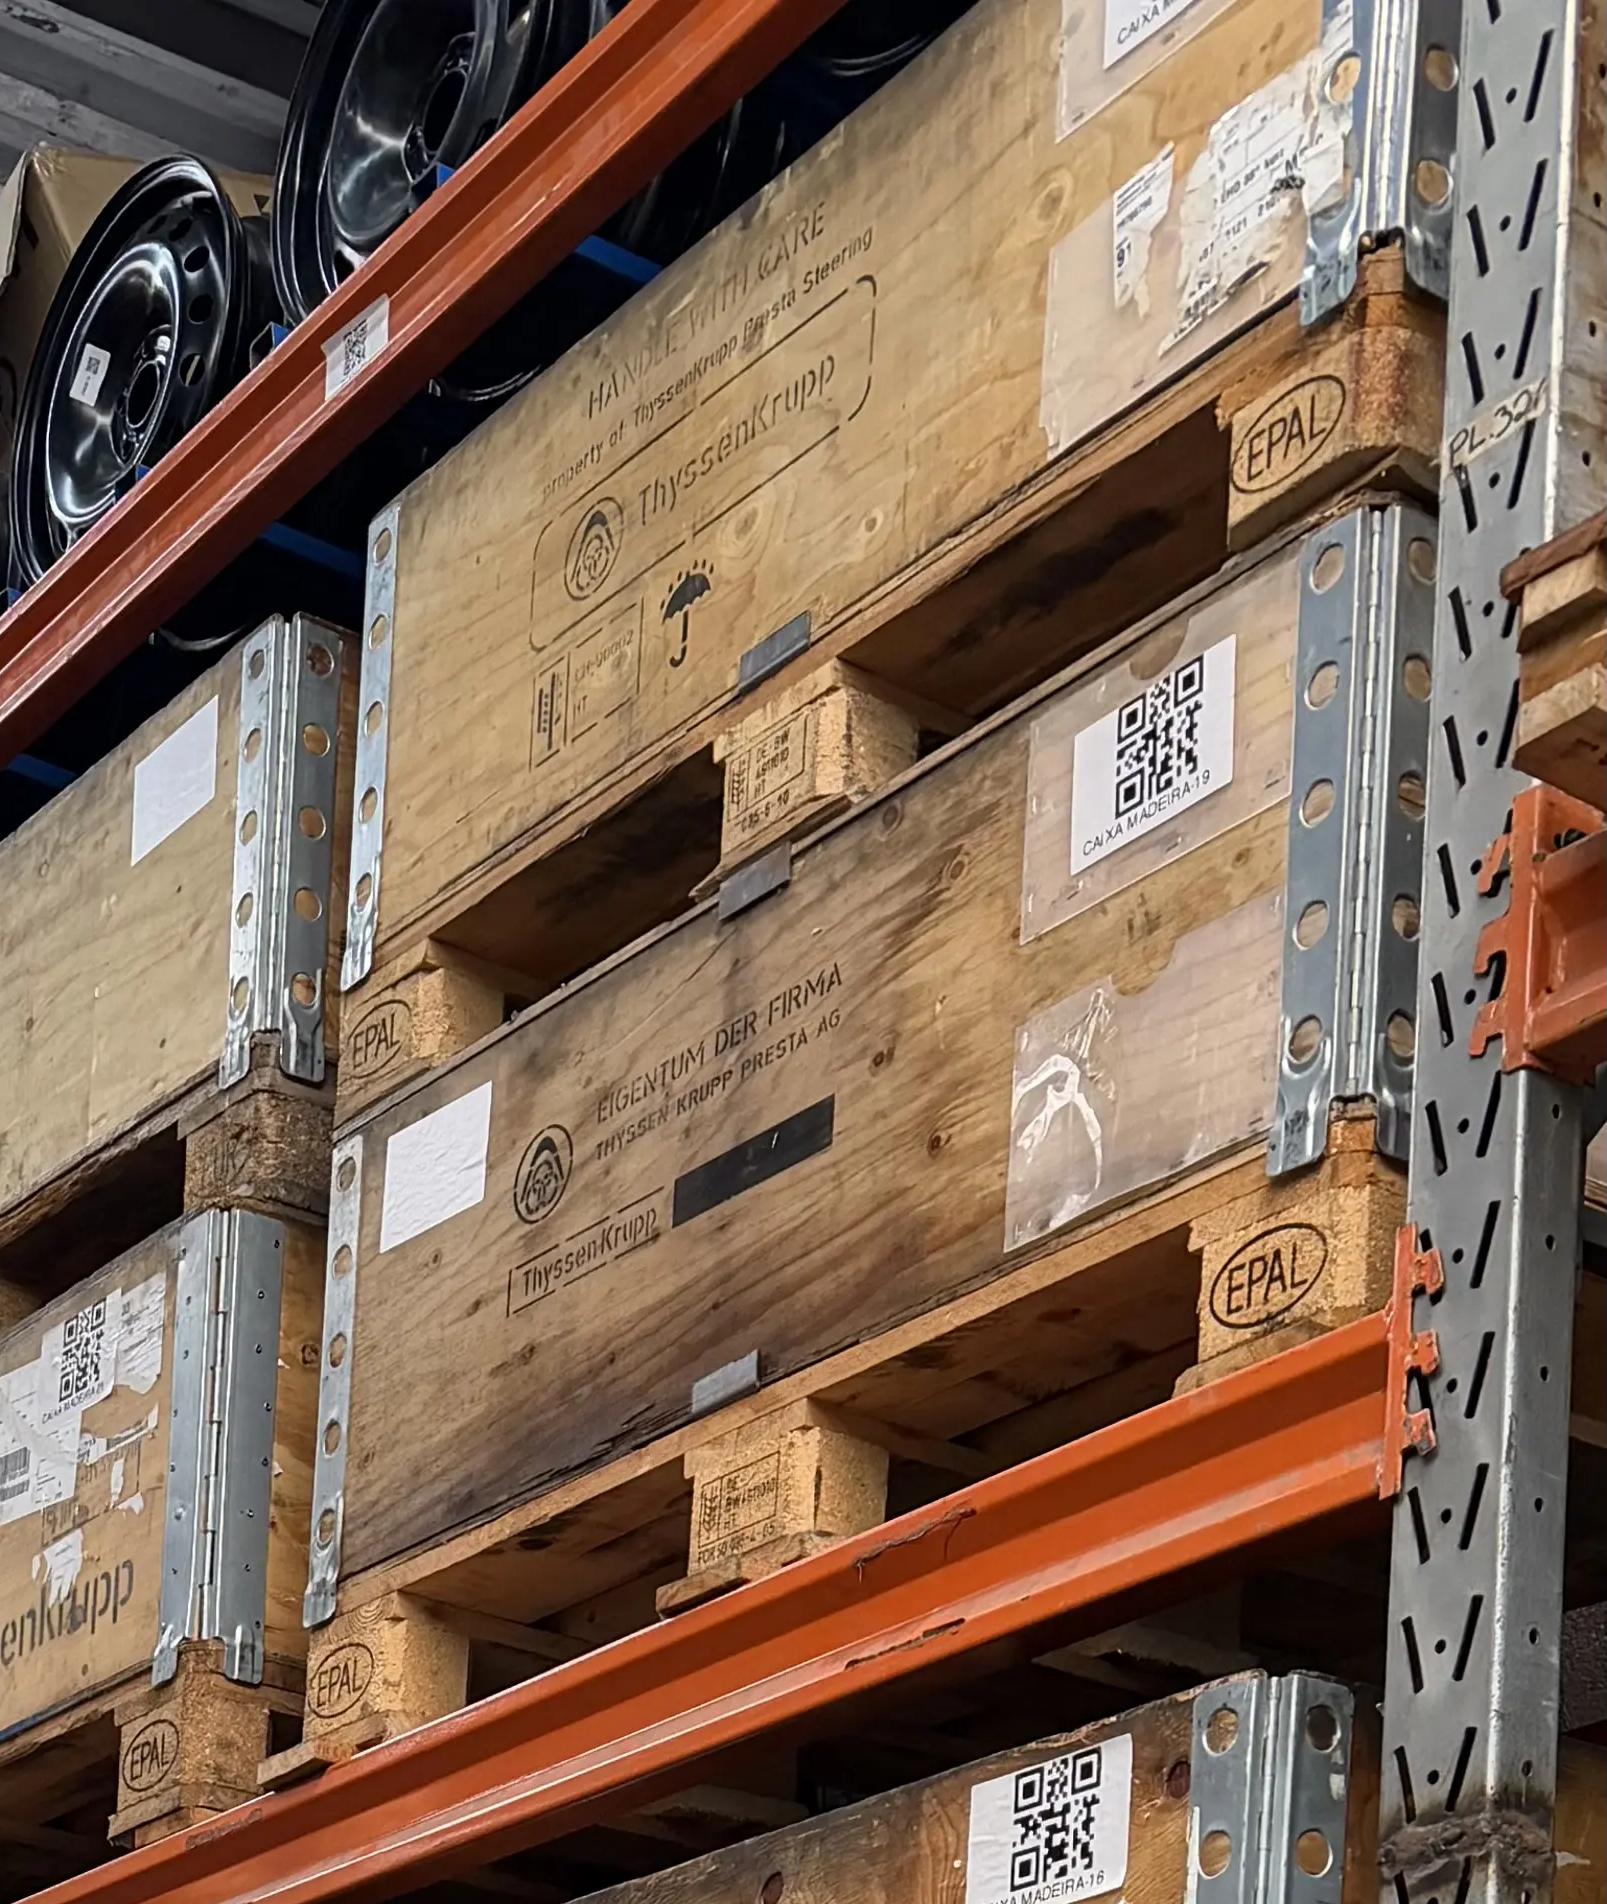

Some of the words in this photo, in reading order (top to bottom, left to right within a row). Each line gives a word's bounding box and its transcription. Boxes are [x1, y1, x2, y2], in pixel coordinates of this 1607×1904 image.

[588, 317, 686, 420] HANDLE
[688, 265, 748, 338] WITH
[758, 201, 826, 281] CARE
[543, 440, 606, 496] property
[633, 334, 739, 427] ThyssenKrupp
[802, 226, 874, 295] Steering
[638, 354, 837, 517] ThyssenKrupp
[1245, 394, 1326, 482] EPAL
[1082, 820, 1124, 857] CAIXA
[1127, 769, 1211, 833] MADEIRA-19
[352, 1018, 401, 1071] EPAL
[595, 1102, 670, 1162] THYSSEN
[676, 1068, 734, 1118] KRUPP
[739, 1026, 809, 1081] PRESTA
[815, 1007, 842, 1039] AG
[597, 1040, 706, 1124] EIGENTUM
[714, 1011, 758, 1058] DER
[768, 961, 843, 1027] FIRMA
[522, 1207, 659, 1297] ThyssenKrupp
[1225, 1242, 1308, 1325] EPAL
[316, 1663, 363, 1708] EPAL
[130, 1737, 169, 1780] EPAL
